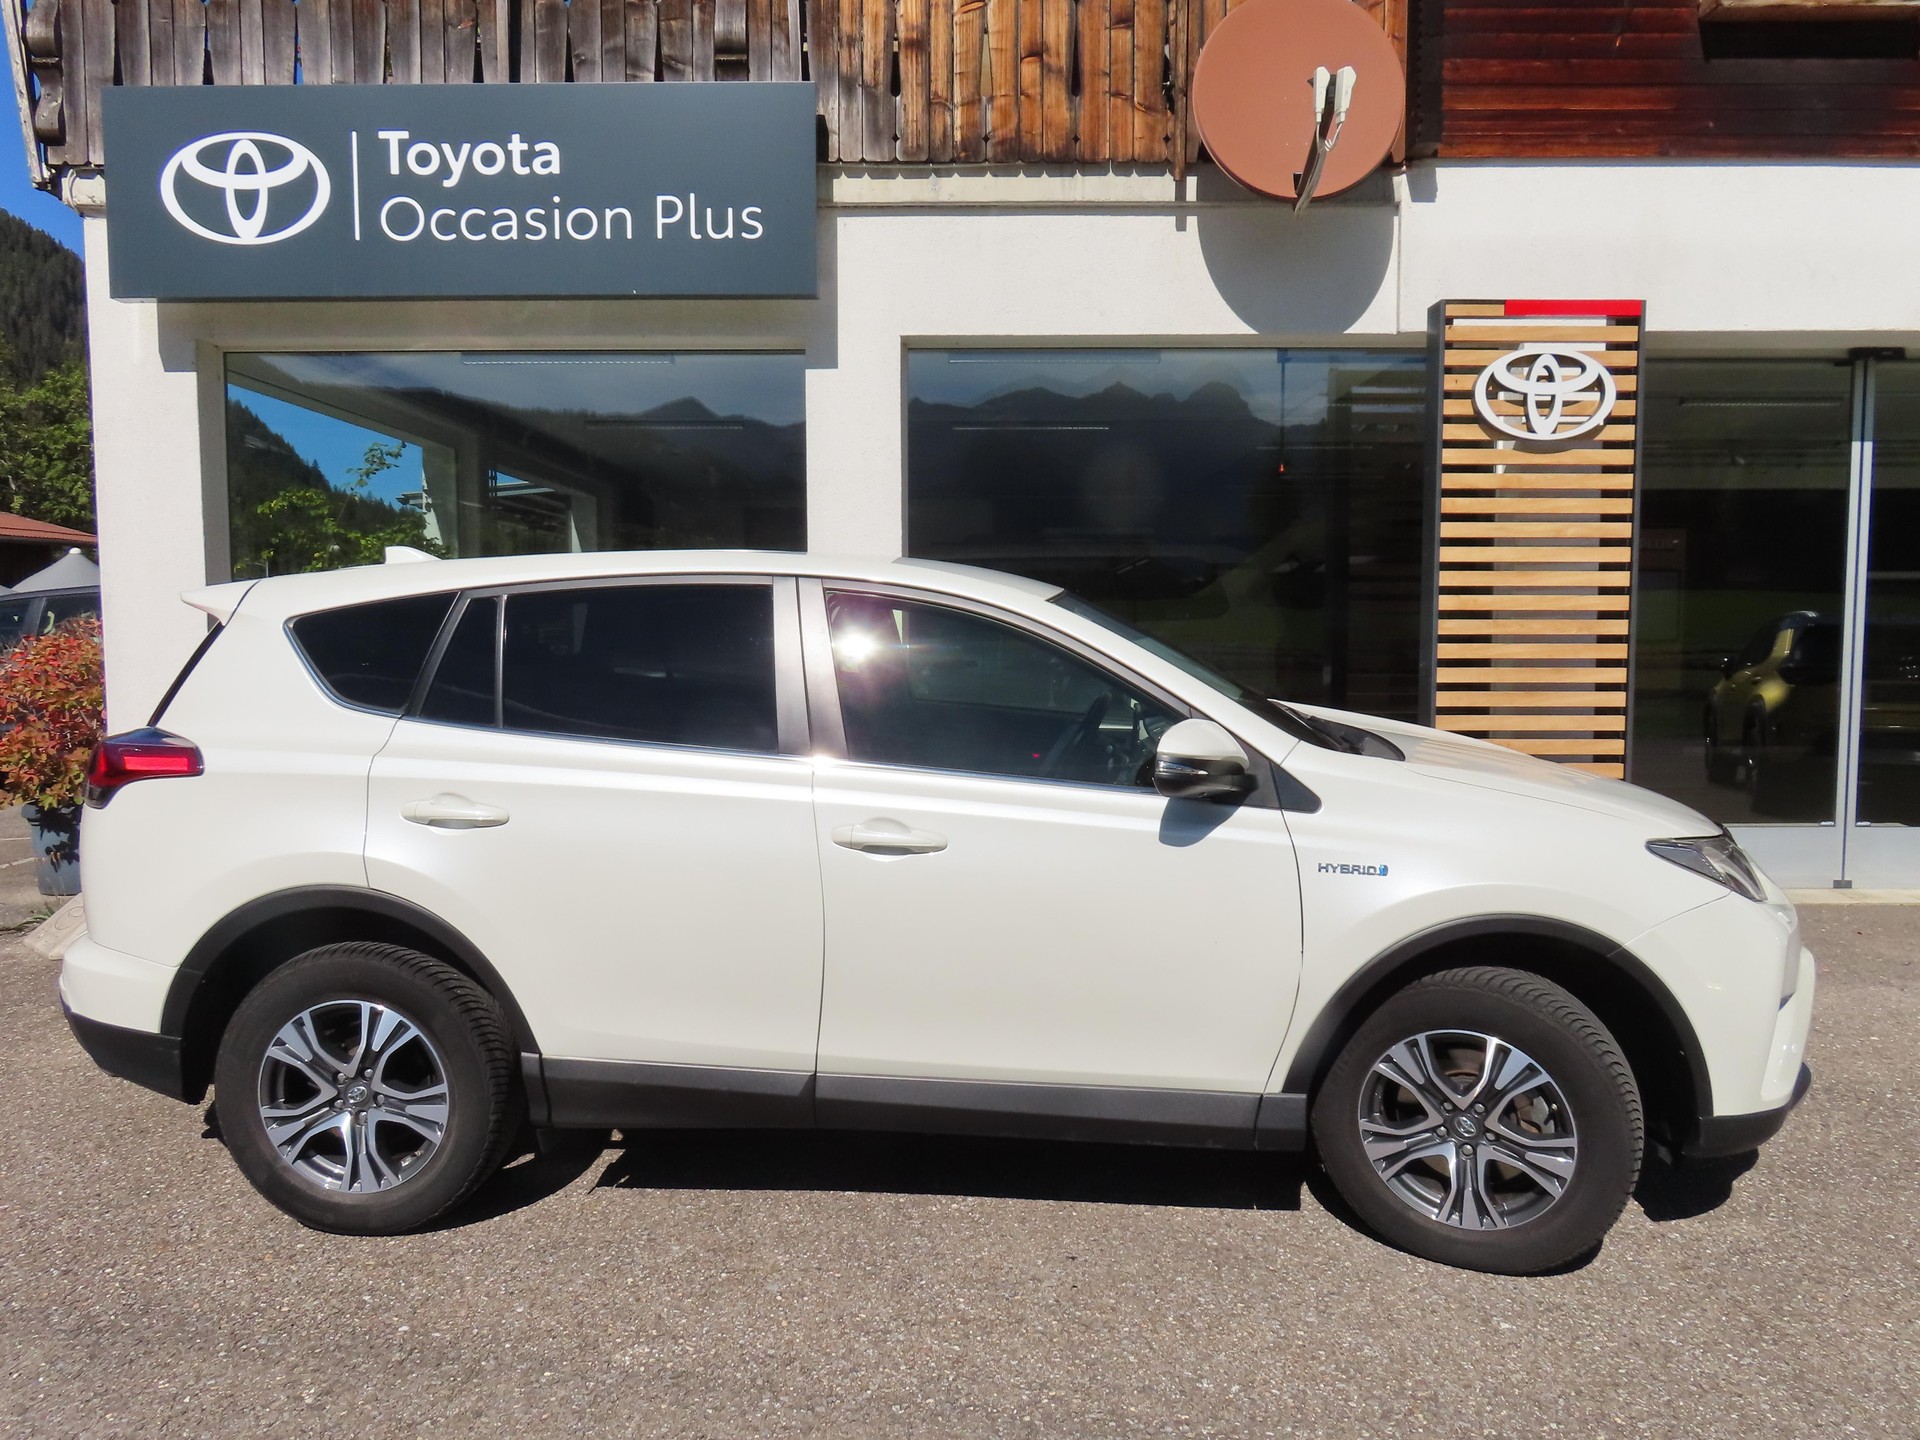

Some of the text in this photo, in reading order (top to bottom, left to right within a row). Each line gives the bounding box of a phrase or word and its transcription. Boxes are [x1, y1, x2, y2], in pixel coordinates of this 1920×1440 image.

[378, 130, 561, 188] Toyota
[380, 192, 764, 242] Occasion Plus
[1318, 862, 1378, 876] HYBRID
